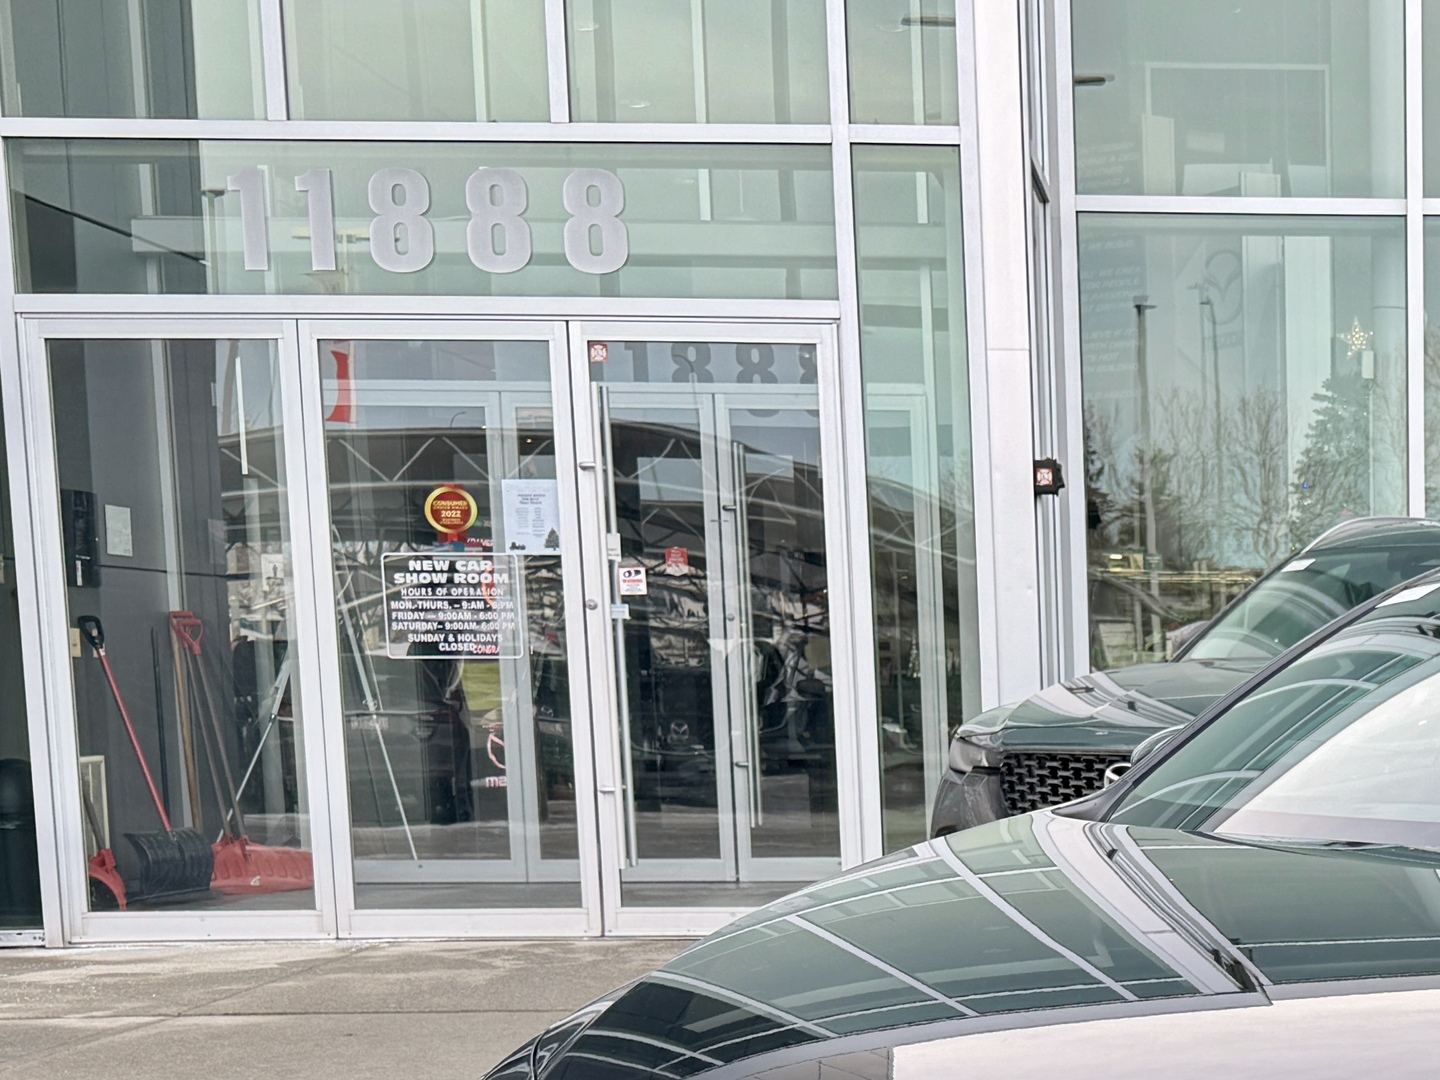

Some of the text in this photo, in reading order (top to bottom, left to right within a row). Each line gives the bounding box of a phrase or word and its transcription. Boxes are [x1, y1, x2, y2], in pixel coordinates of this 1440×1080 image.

[226, 167, 629, 274] 11888
[441, 510, 462, 518] 2022
[408, 560, 493, 571] NEW CAR
[393, 573, 509, 584] SHOW ROOM
[401, 587, 504, 596] HOURS OF OPERATION
[462, 601, 485, 610] 9:AM
[391, 611, 425, 620] FRIDAY
[438, 611, 472, 620] 9:00AM
[479, 611, 499, 620] 6:00
[501, 611, 515, 620] PM
[481, 621, 500, 630] 6:00
[502, 621, 516, 630] PM
[407, 633, 503, 642] SUNDAY & HOLIDAYS
[438, 642, 474, 651] CLOSED
